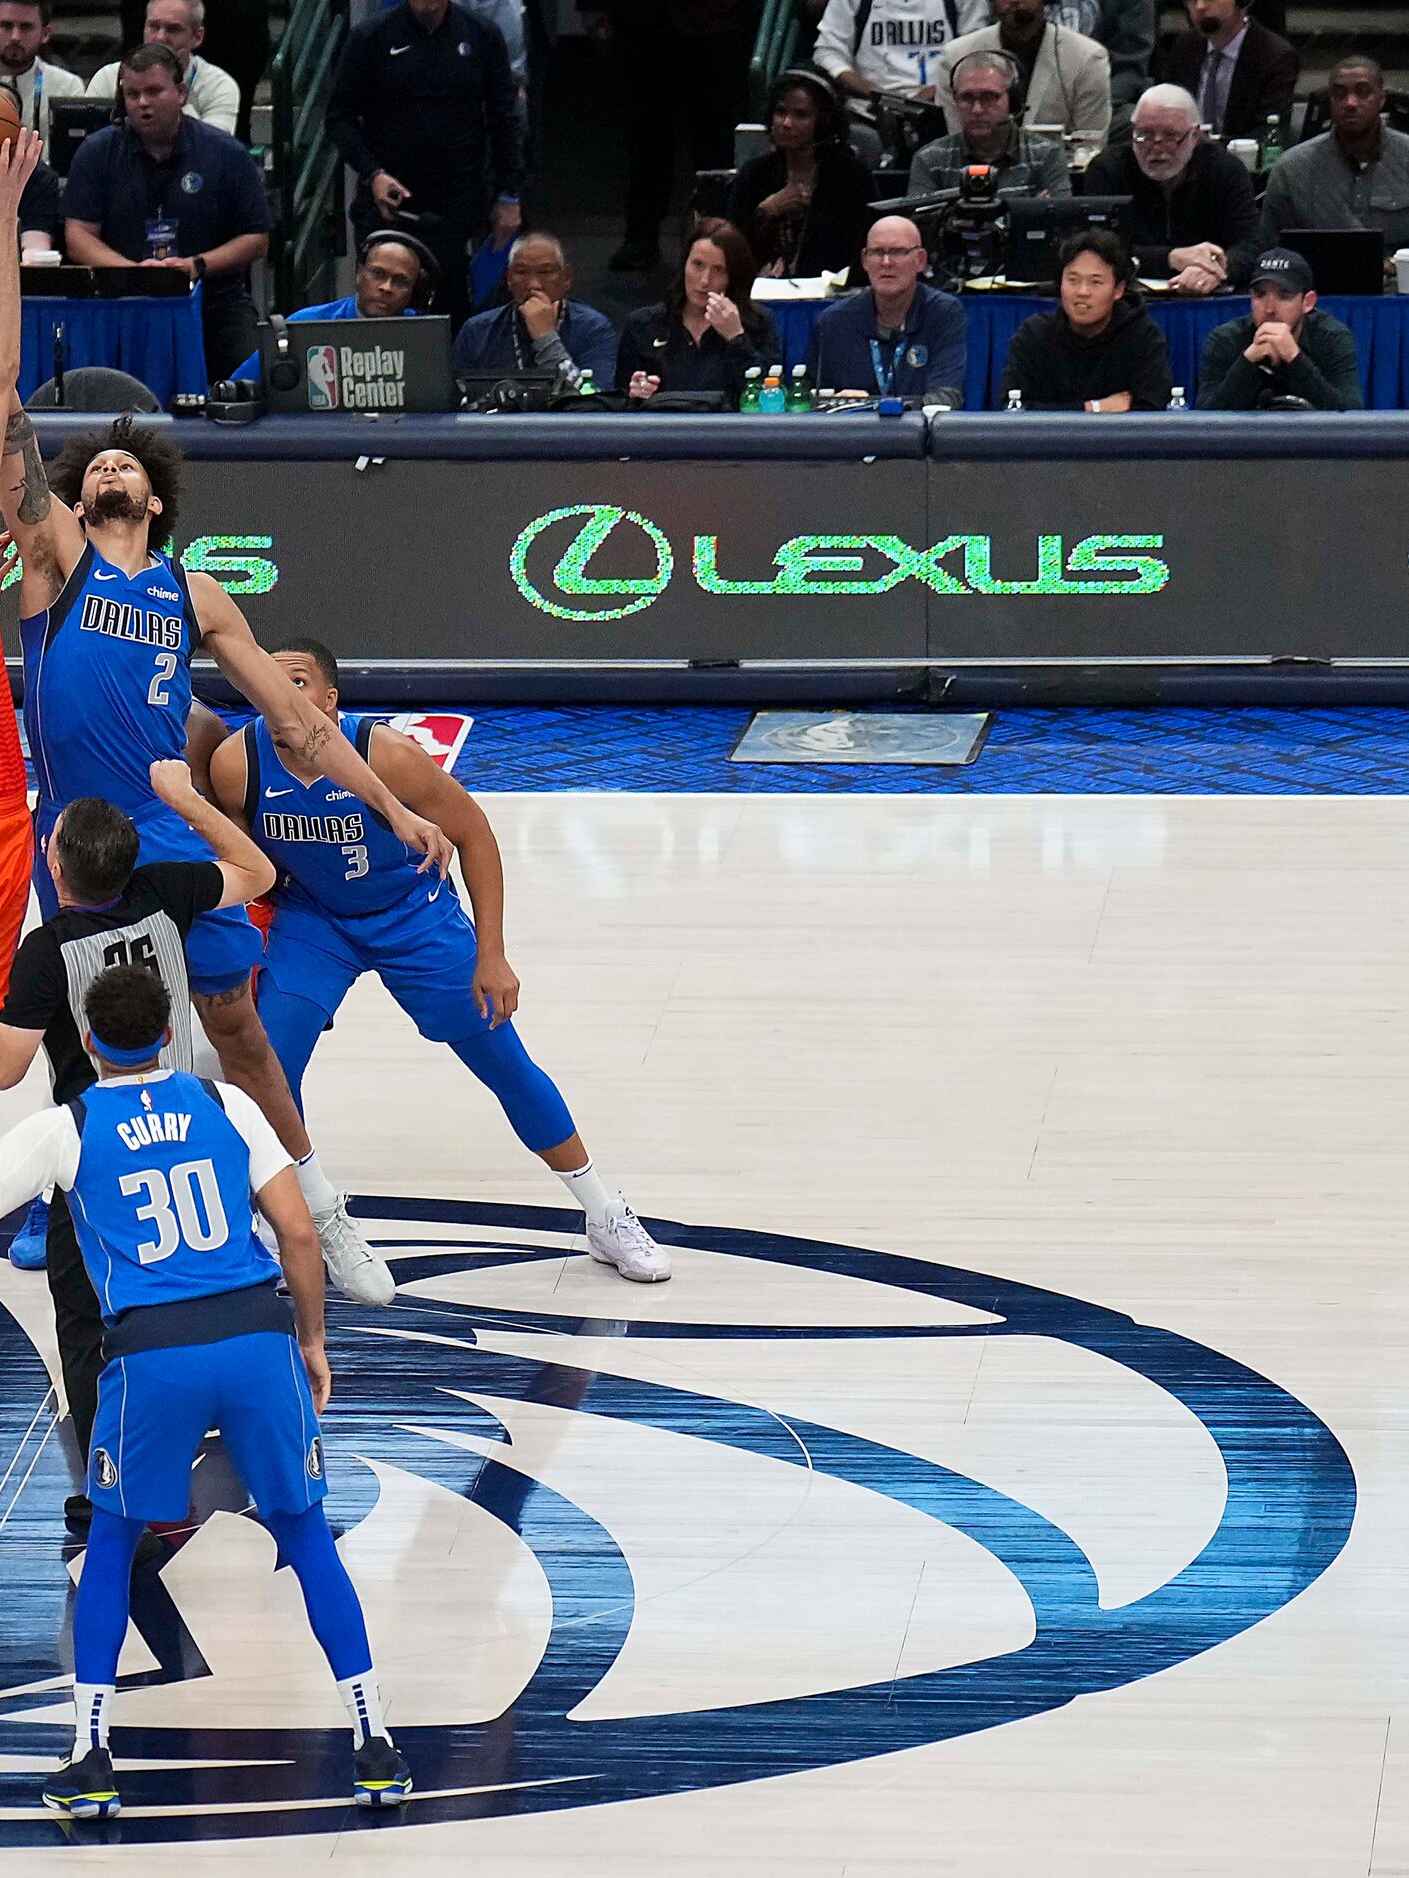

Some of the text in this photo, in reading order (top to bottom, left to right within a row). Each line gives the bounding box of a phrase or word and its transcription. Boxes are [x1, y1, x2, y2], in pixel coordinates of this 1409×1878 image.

[341, 345, 404, 381] Replay
[342, 377, 406, 408] Center
[693, 534, 1171, 595] LEXUS
[147, 586, 179, 602] chime
[80, 594, 182, 650] DALLAS
[147, 652, 177, 705] 2
[325, 789, 356, 802] chim
[263, 812, 364, 843] DALLAS
[341, 845, 369, 881] 3
[116, 1112, 192, 1151] CURRY
[118, 1158, 230, 1265] 30
